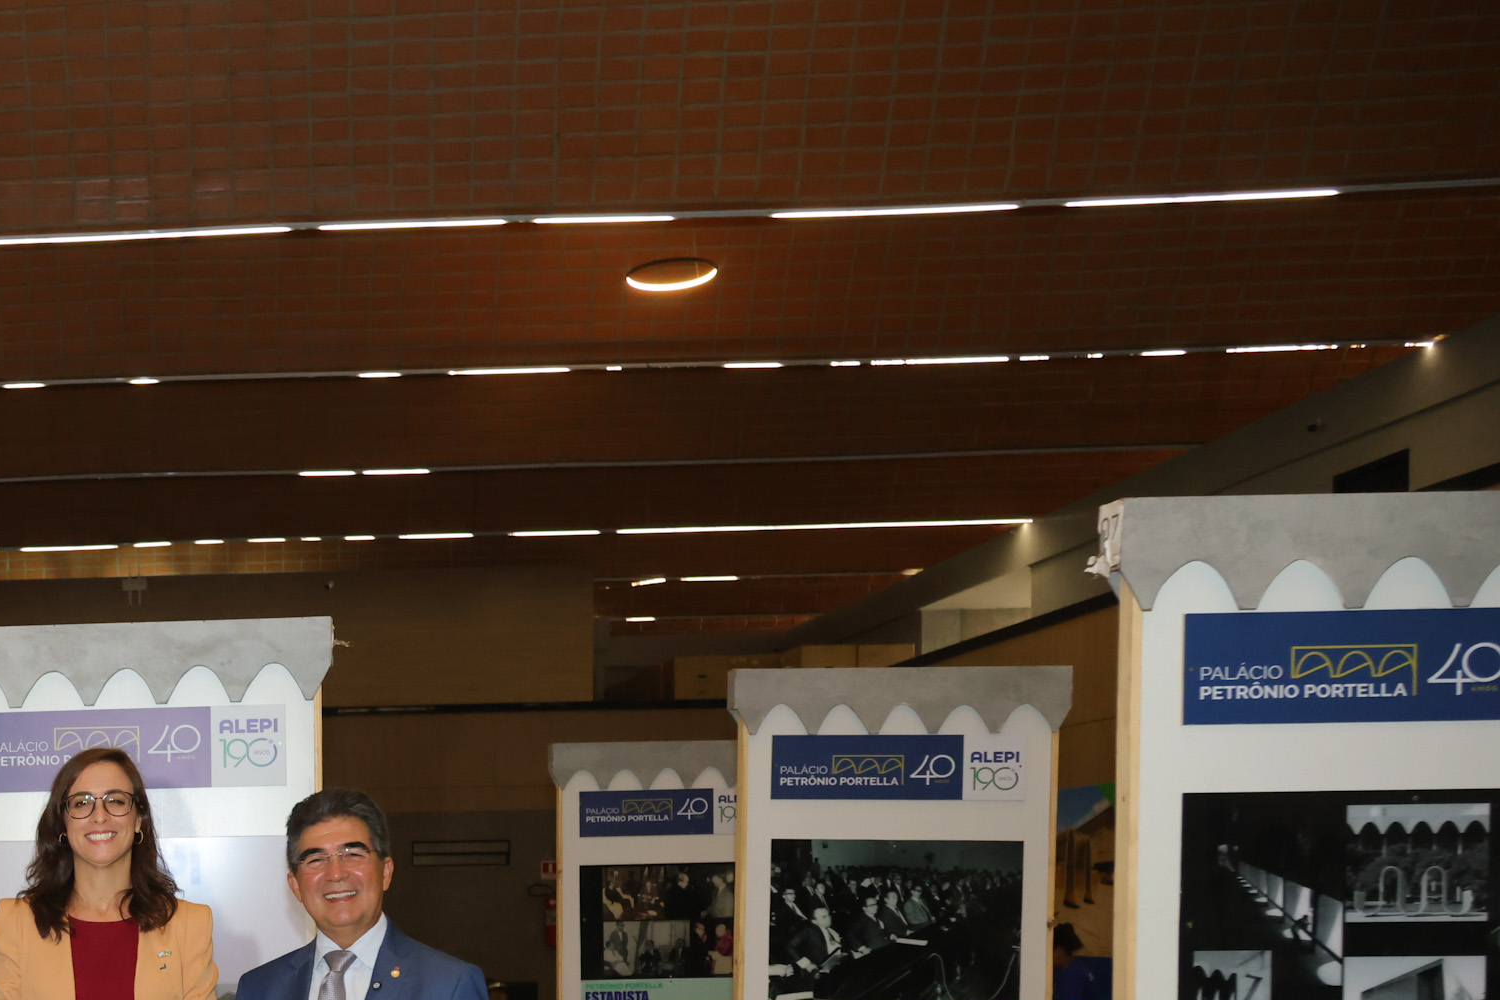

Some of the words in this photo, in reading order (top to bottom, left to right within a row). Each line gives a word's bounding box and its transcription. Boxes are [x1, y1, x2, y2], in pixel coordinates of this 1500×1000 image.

[1200, 662, 1282, 680] PALÁCIO
[1200, 683, 1299, 700] PETRÔNIO
[1304, 683, 1408, 698] PORTELLA
[219, 718, 278, 734] ALEPI
[148, 724, 201, 762] 40
[219, 738, 278, 768] 190
[970, 752, 1020, 762] ALEPI
[780, 764, 828, 774] PALÁCIO
[910, 754, 956, 786] 40
[780, 776, 837, 786] PETRÔNIO
[840, 777, 898, 786] PORTELLA
[970, 767, 1018, 790] 190
[677, 798, 708, 820] 40
[628, 814, 669, 822] PORTELLA
